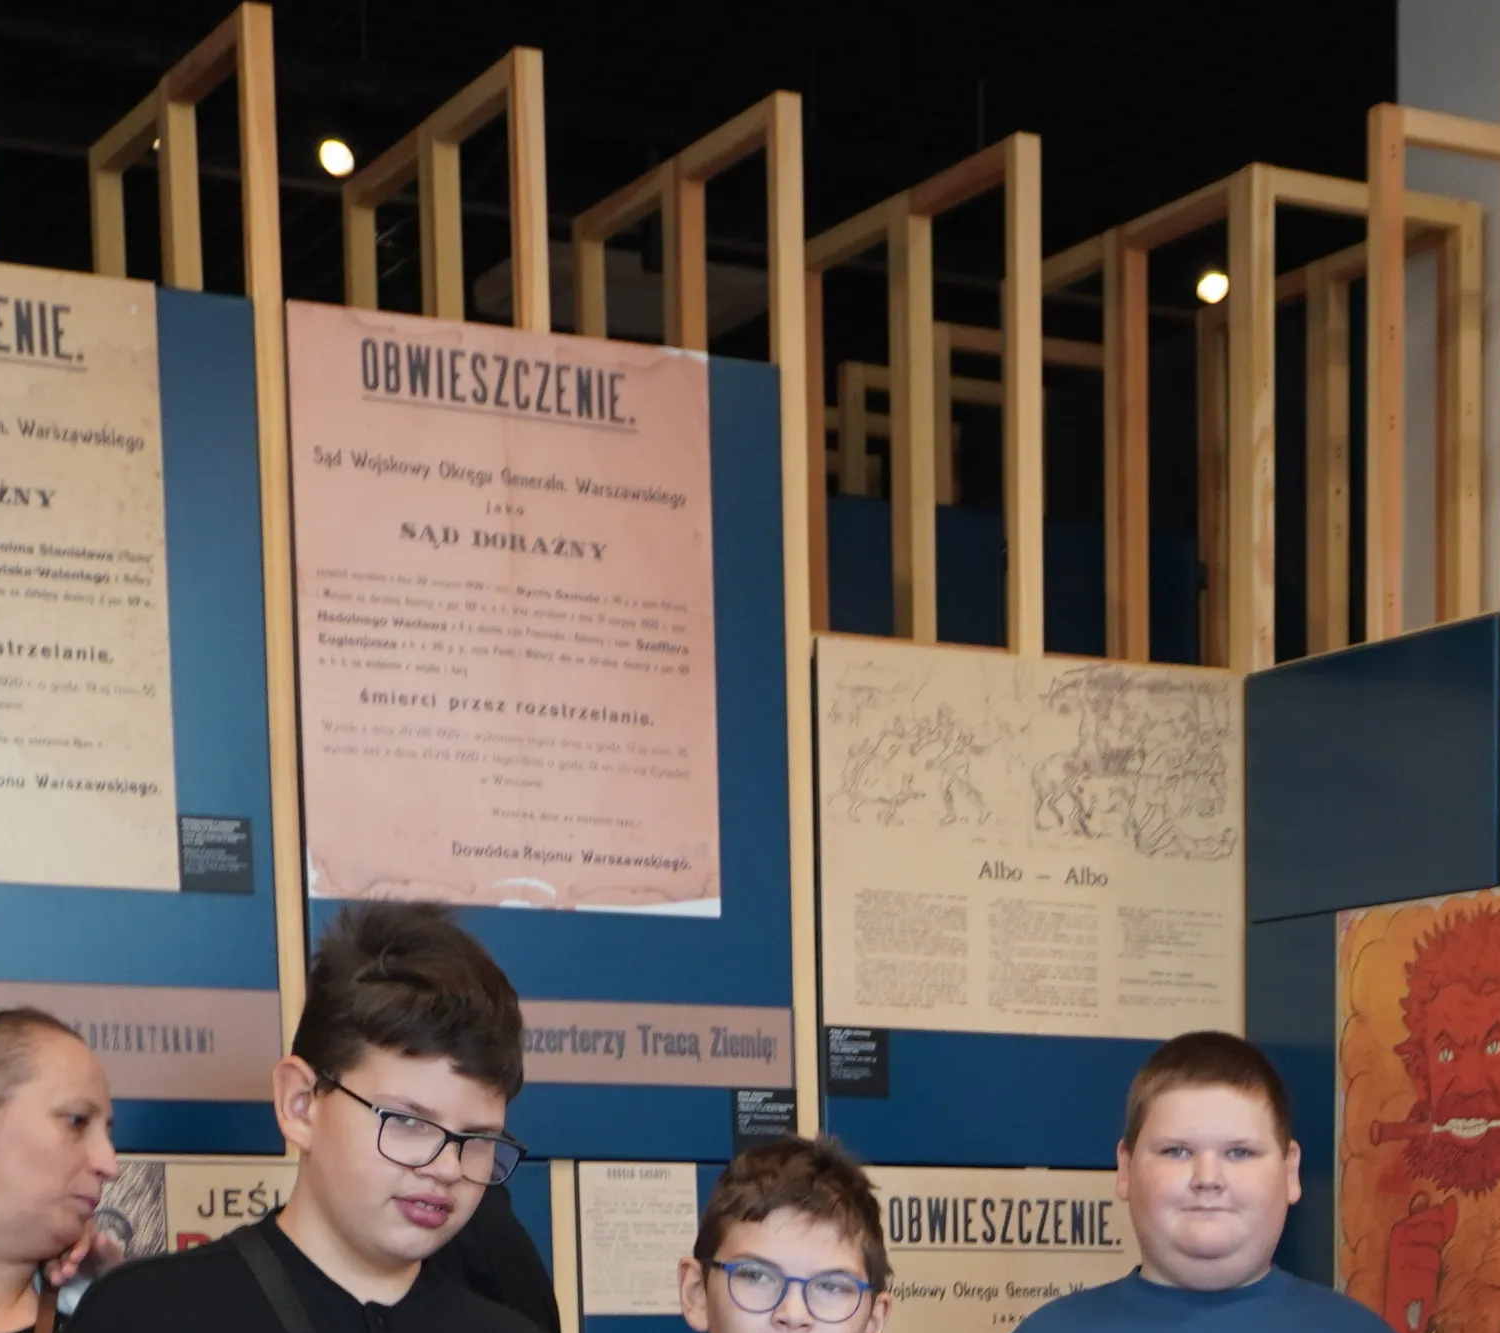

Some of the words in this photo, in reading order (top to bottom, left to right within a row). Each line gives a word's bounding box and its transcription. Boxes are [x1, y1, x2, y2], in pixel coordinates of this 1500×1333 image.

[360, 337, 637, 426] OBWIESZCZENIE.
[17, 417, 146, 453] Warszawskiego
[313, 445, 342, 468] Sąd
[349, 449, 431, 480] Wojskowy
[438, 460, 493, 486] Okręgu
[575, 476, 687, 510] Warszawskiego
[400, 522, 459, 551] SĄD
[360, 687, 437, 710] śmierci
[449, 694, 506, 714] przez
[515, 700, 655, 727] rozstrzelanie.
[977, 861, 1024, 882] Albo
[1064, 866, 1109, 888] Albo
[637, 1021, 702, 1063] Tracą
[888, 1196, 1122, 1246] OBWIESZCZENIE.
[952, 1282, 999, 1302] Okręgu
